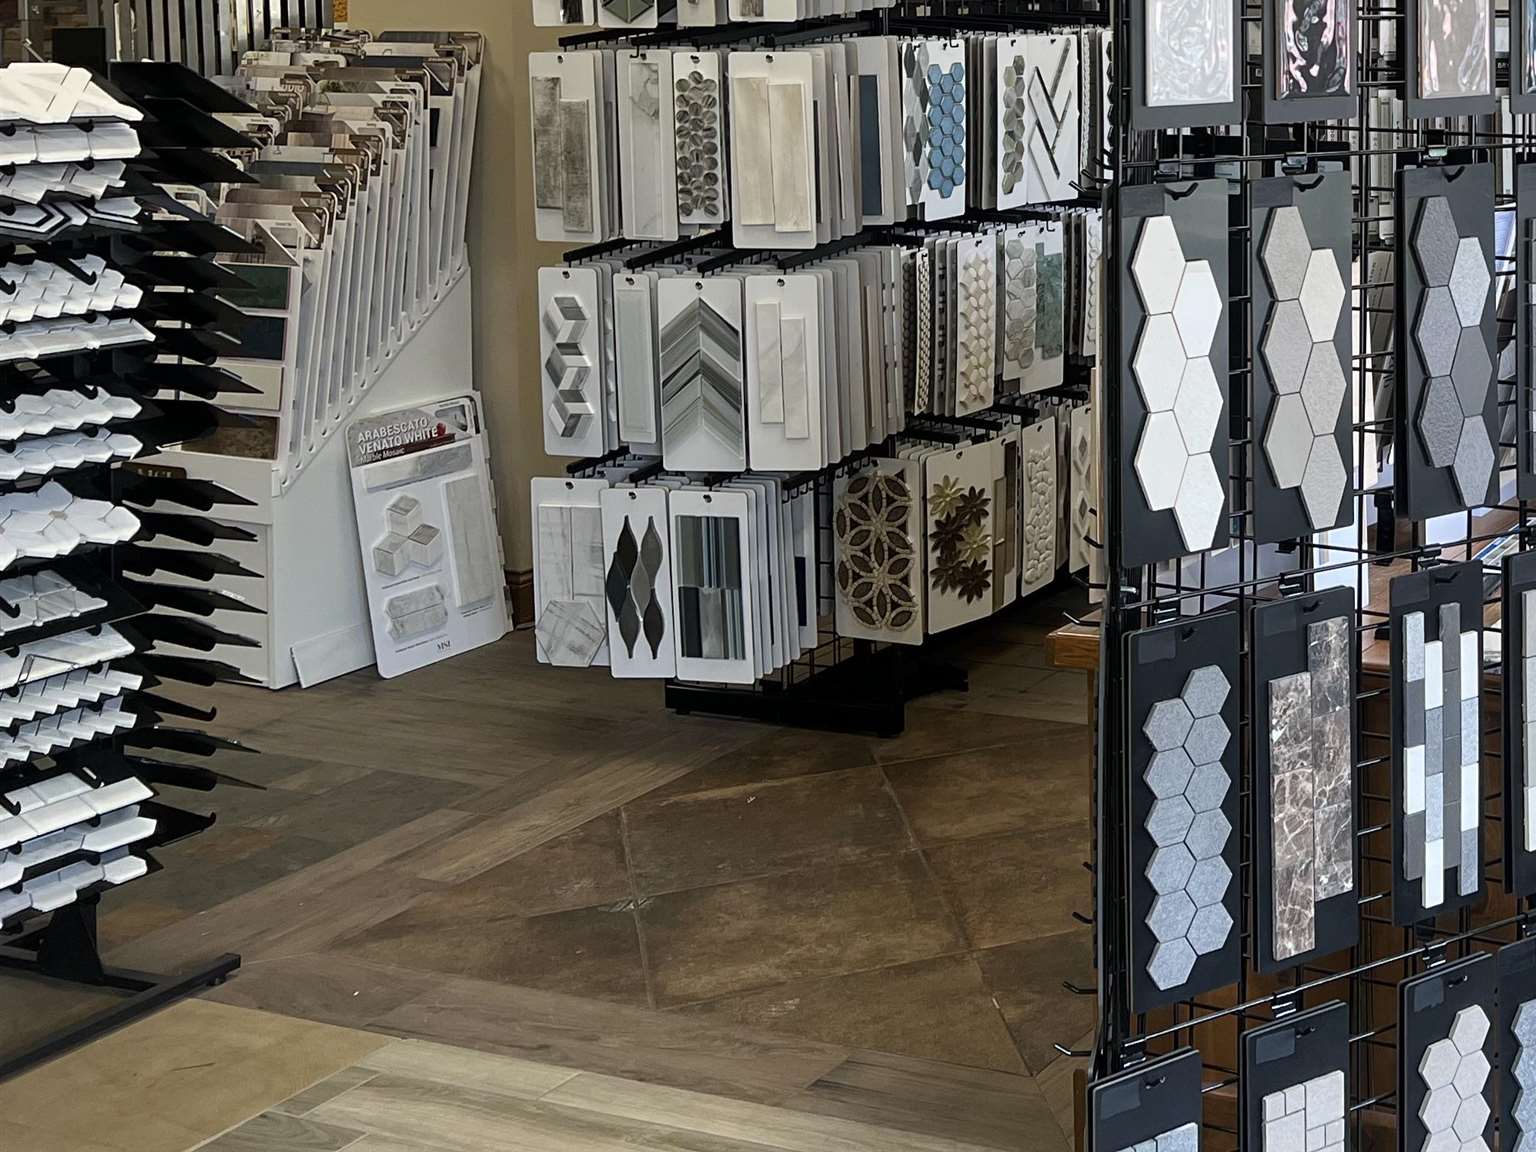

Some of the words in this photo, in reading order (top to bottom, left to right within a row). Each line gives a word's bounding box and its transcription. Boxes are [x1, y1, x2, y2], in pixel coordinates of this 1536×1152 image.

[358, 416, 429, 443] ARABESCATO
[358, 435, 402, 455] VENATO
[402, 427, 439, 444] WHITE
